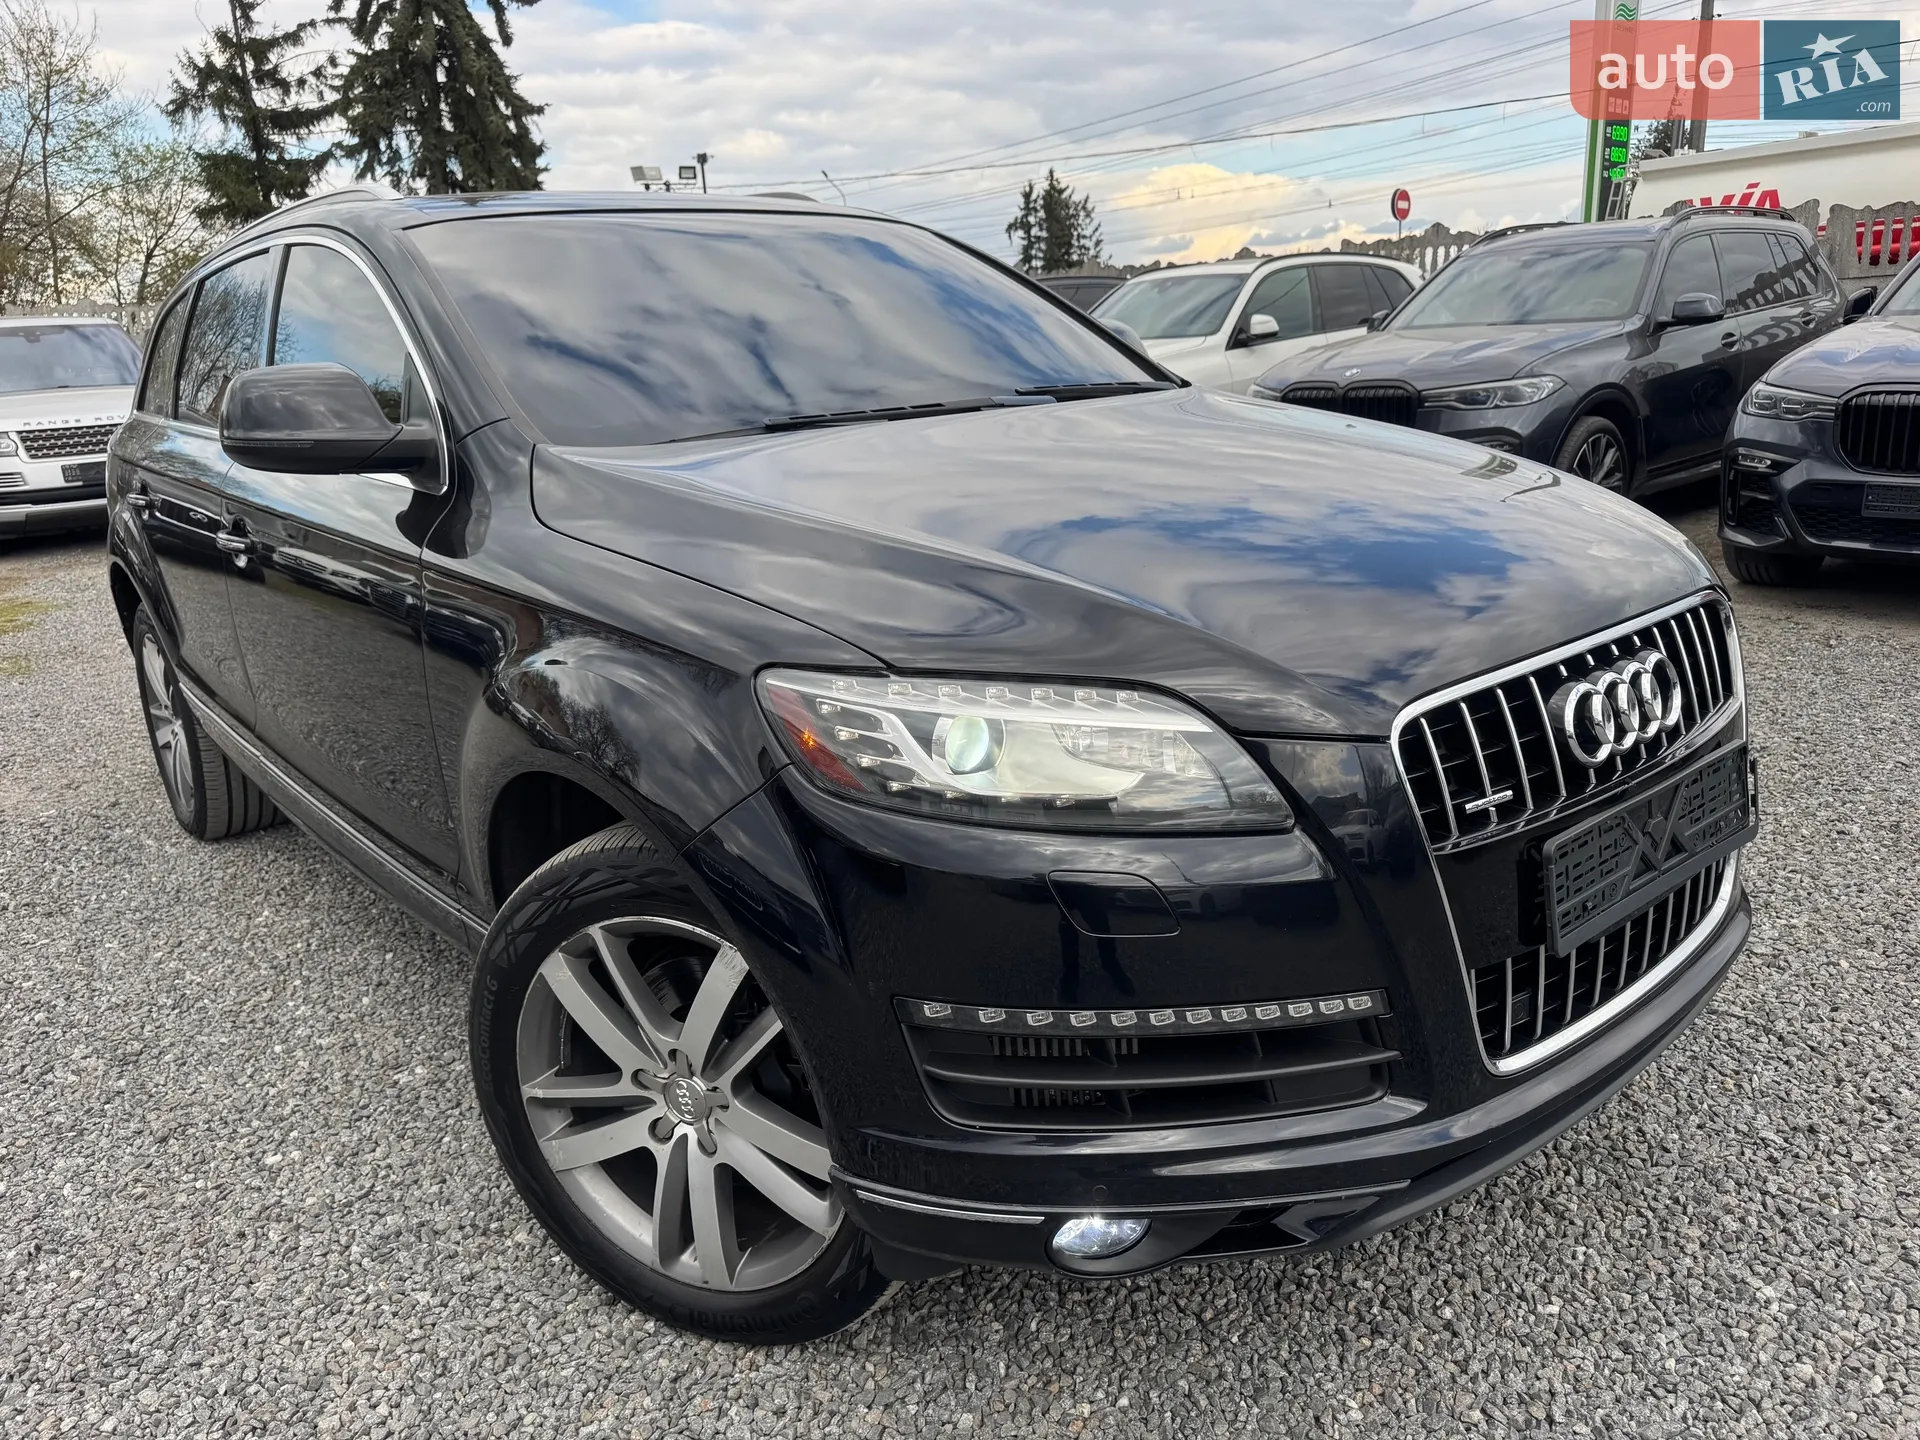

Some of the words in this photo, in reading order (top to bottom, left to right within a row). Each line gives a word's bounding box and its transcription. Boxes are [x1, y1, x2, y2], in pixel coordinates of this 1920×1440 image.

[23, 419, 81, 427] RANGE
[94, 414, 126, 422] ROV
[478, 989, 496, 1090] EcoContact
